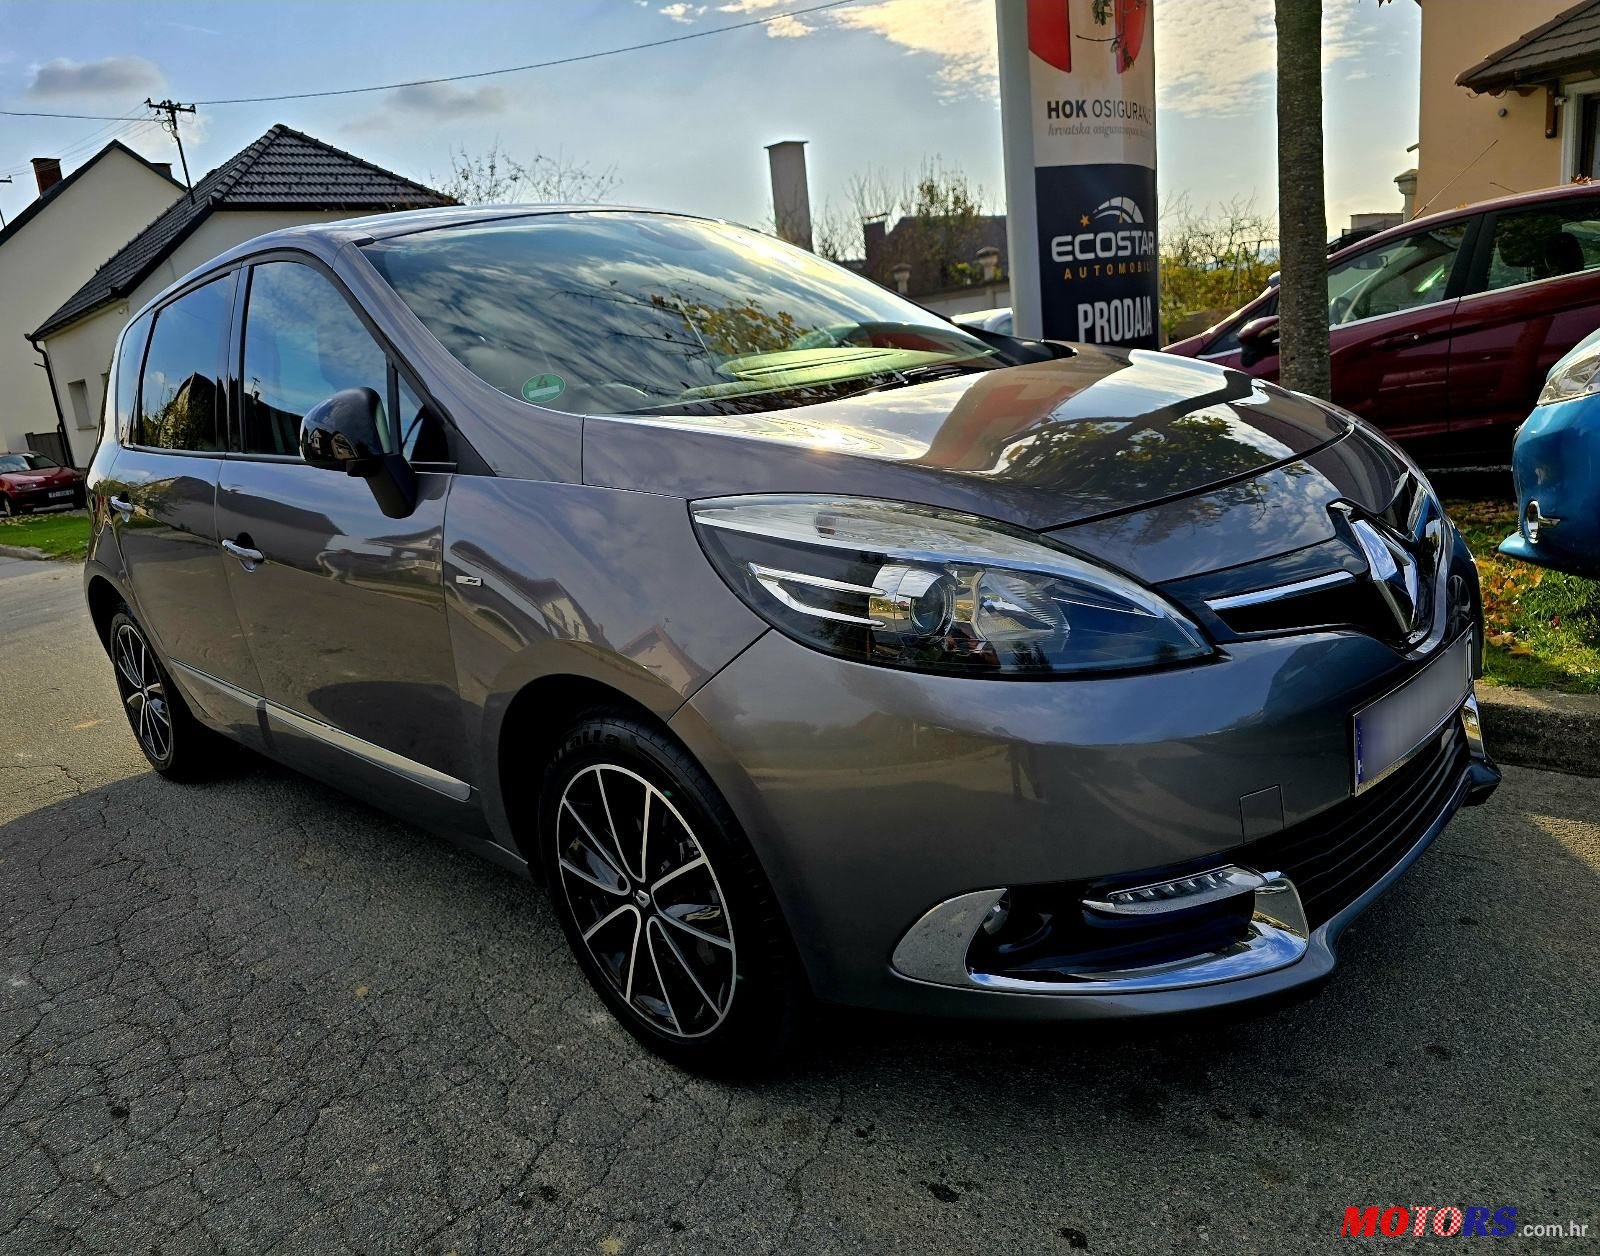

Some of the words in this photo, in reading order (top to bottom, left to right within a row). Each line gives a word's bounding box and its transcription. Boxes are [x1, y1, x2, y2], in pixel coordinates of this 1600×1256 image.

[1047, 99, 1088, 119] HOK
[1047, 121, 1090, 136] hrvatska
[1051, 230, 1155, 262] ECOSTAR
[1077, 296, 1153, 344] PRODAJA
